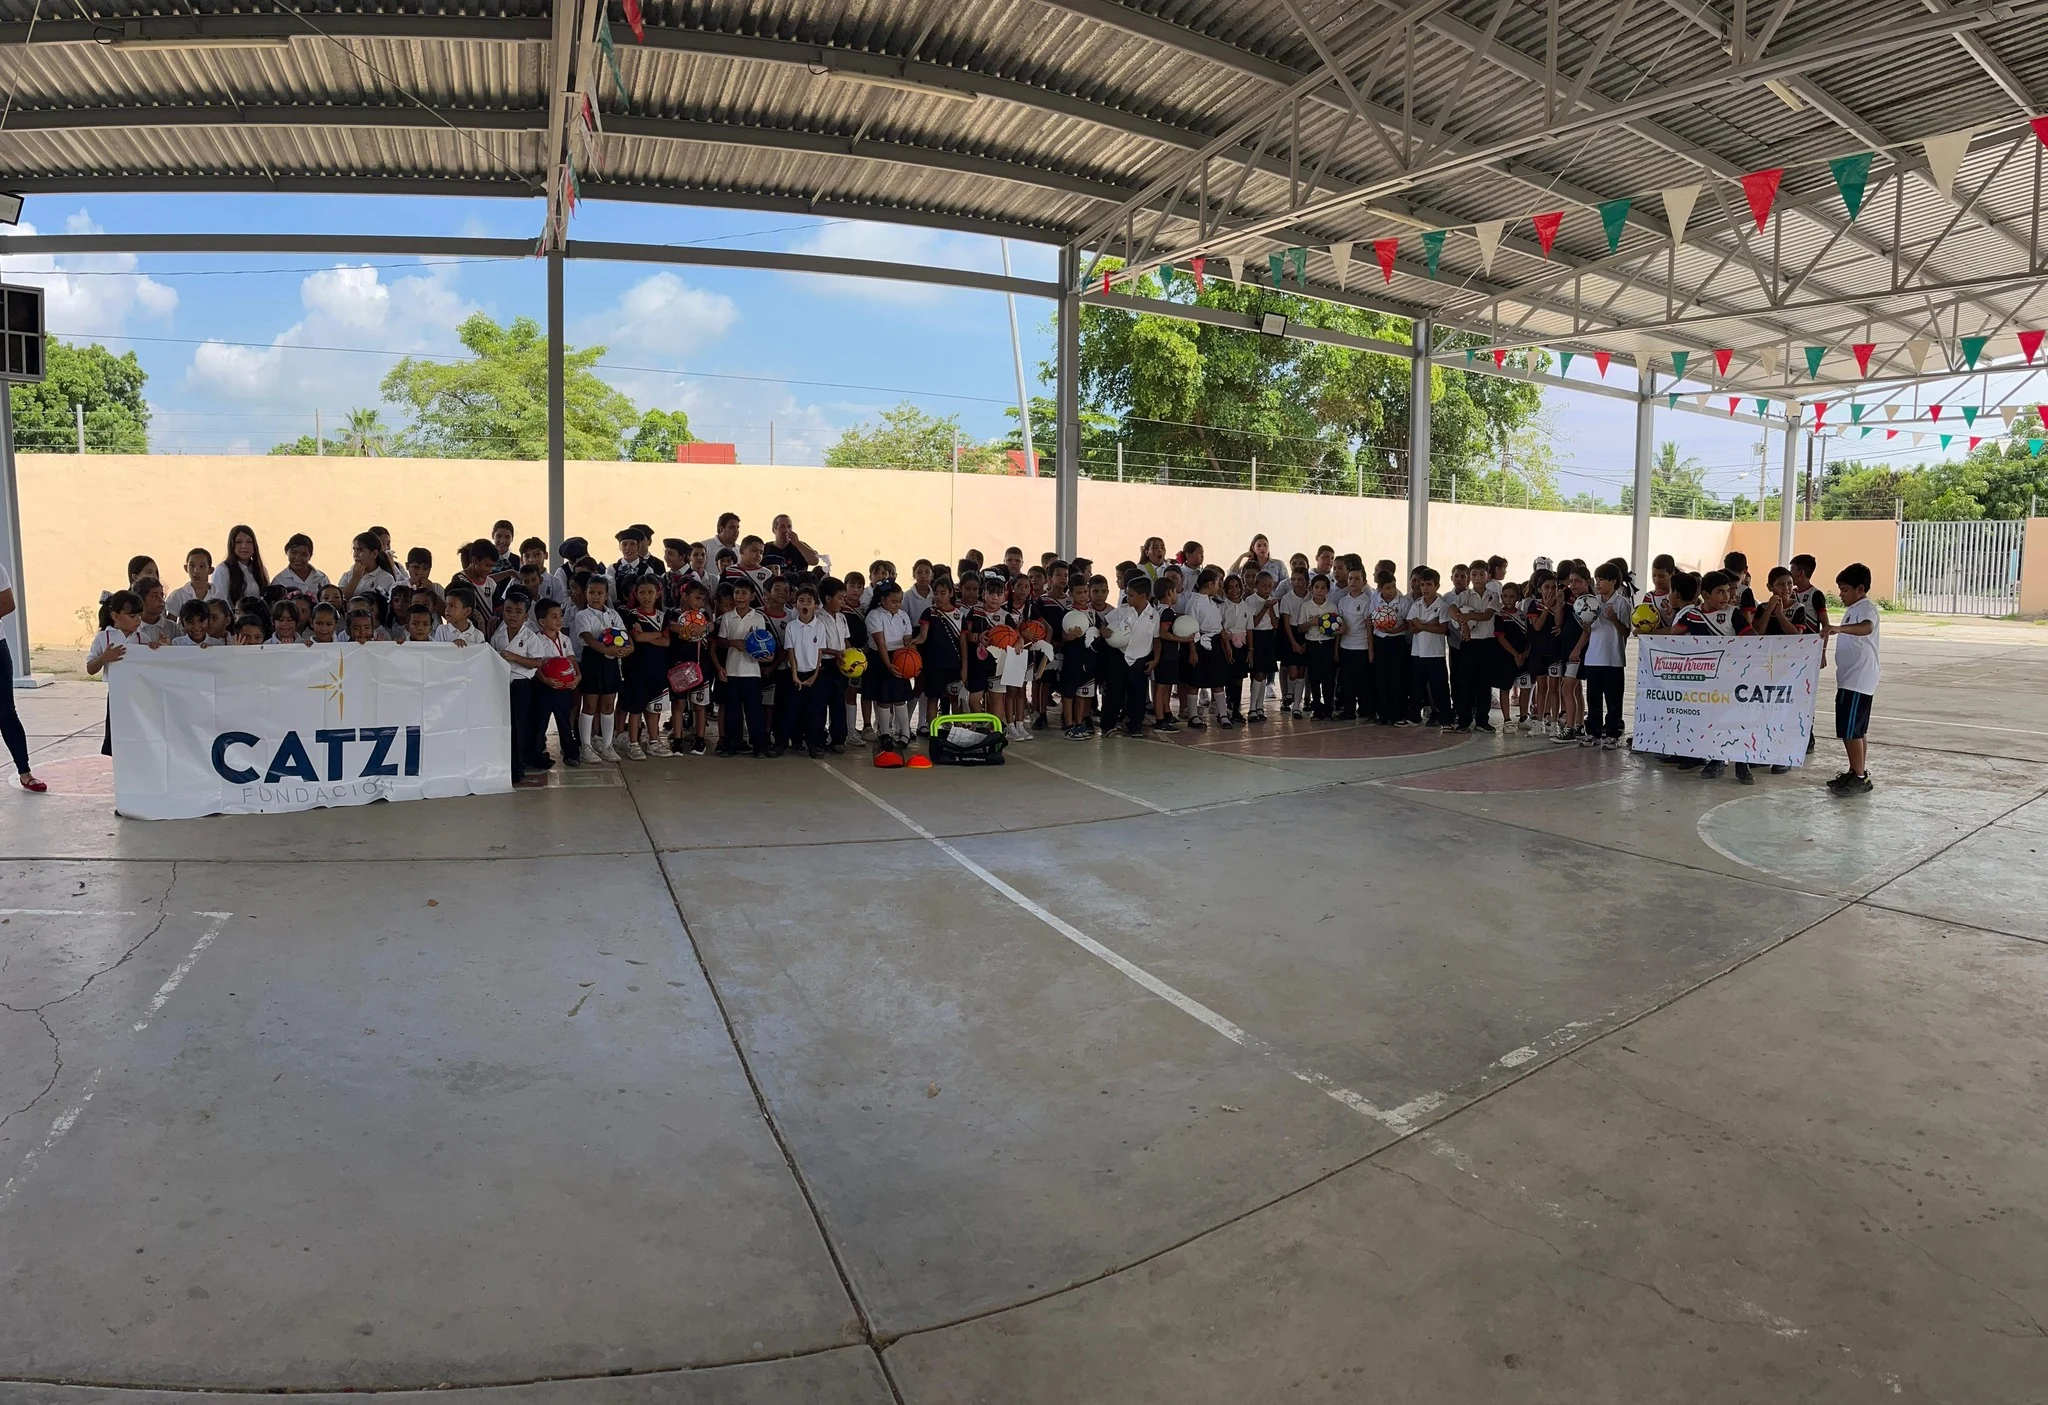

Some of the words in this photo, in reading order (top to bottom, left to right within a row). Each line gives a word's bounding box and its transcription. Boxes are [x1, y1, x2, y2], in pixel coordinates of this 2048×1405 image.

[1654, 656, 1683, 673] Krispy
[1684, 657, 1717, 671] Kreme
[1646, 689, 1730, 704] RECAUDACCIÓN
[1735, 684, 1793, 703] CATZI
[1666, 707, 1675, 715] DE
[1676, 708, 1700, 716] FONDOS
[211, 726, 421, 784] CATZI
[242, 777, 394, 803] FUNDACIÓN
